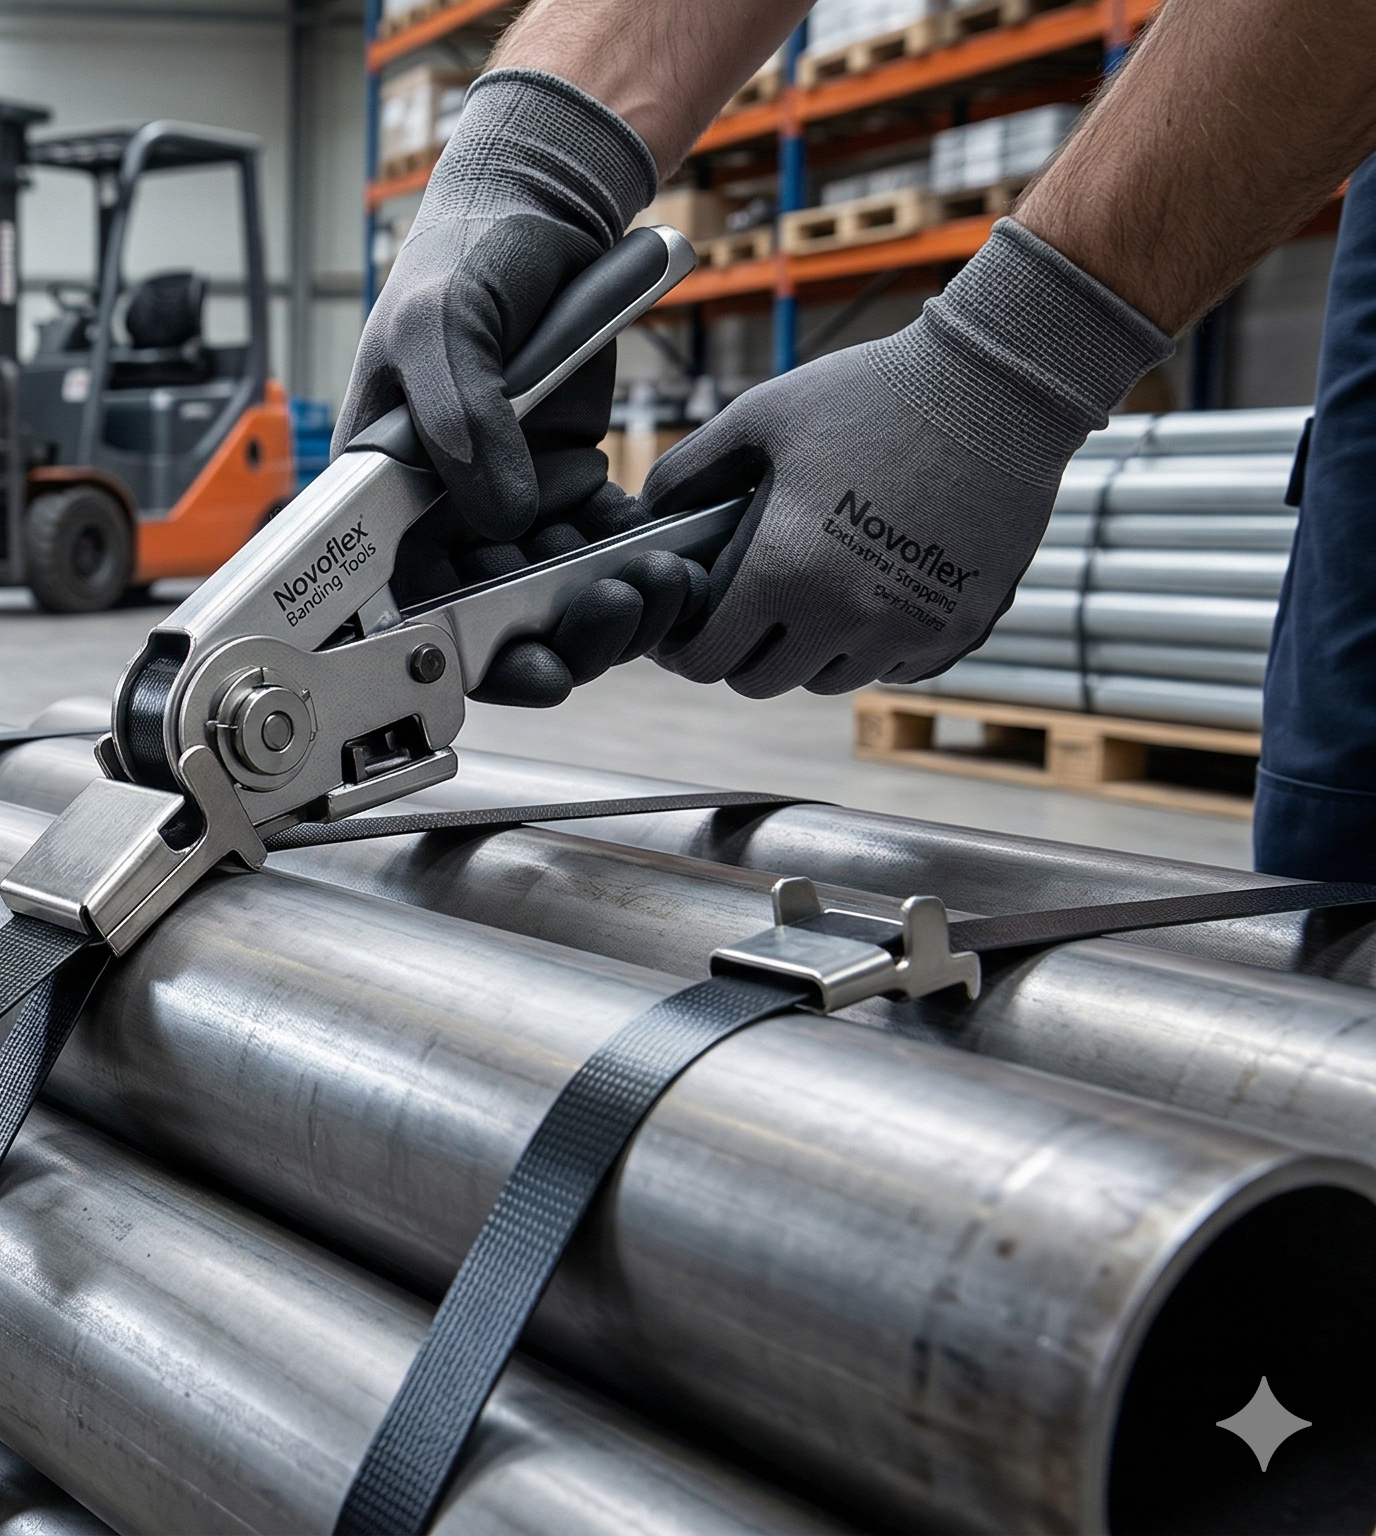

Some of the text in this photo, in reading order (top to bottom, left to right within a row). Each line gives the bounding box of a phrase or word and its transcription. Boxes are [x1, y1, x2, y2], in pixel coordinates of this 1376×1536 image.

[272, 521, 369, 612] Novoflex
[286, 542, 376, 627] Banding Tools
[833, 489, 972, 593] Novoflex
